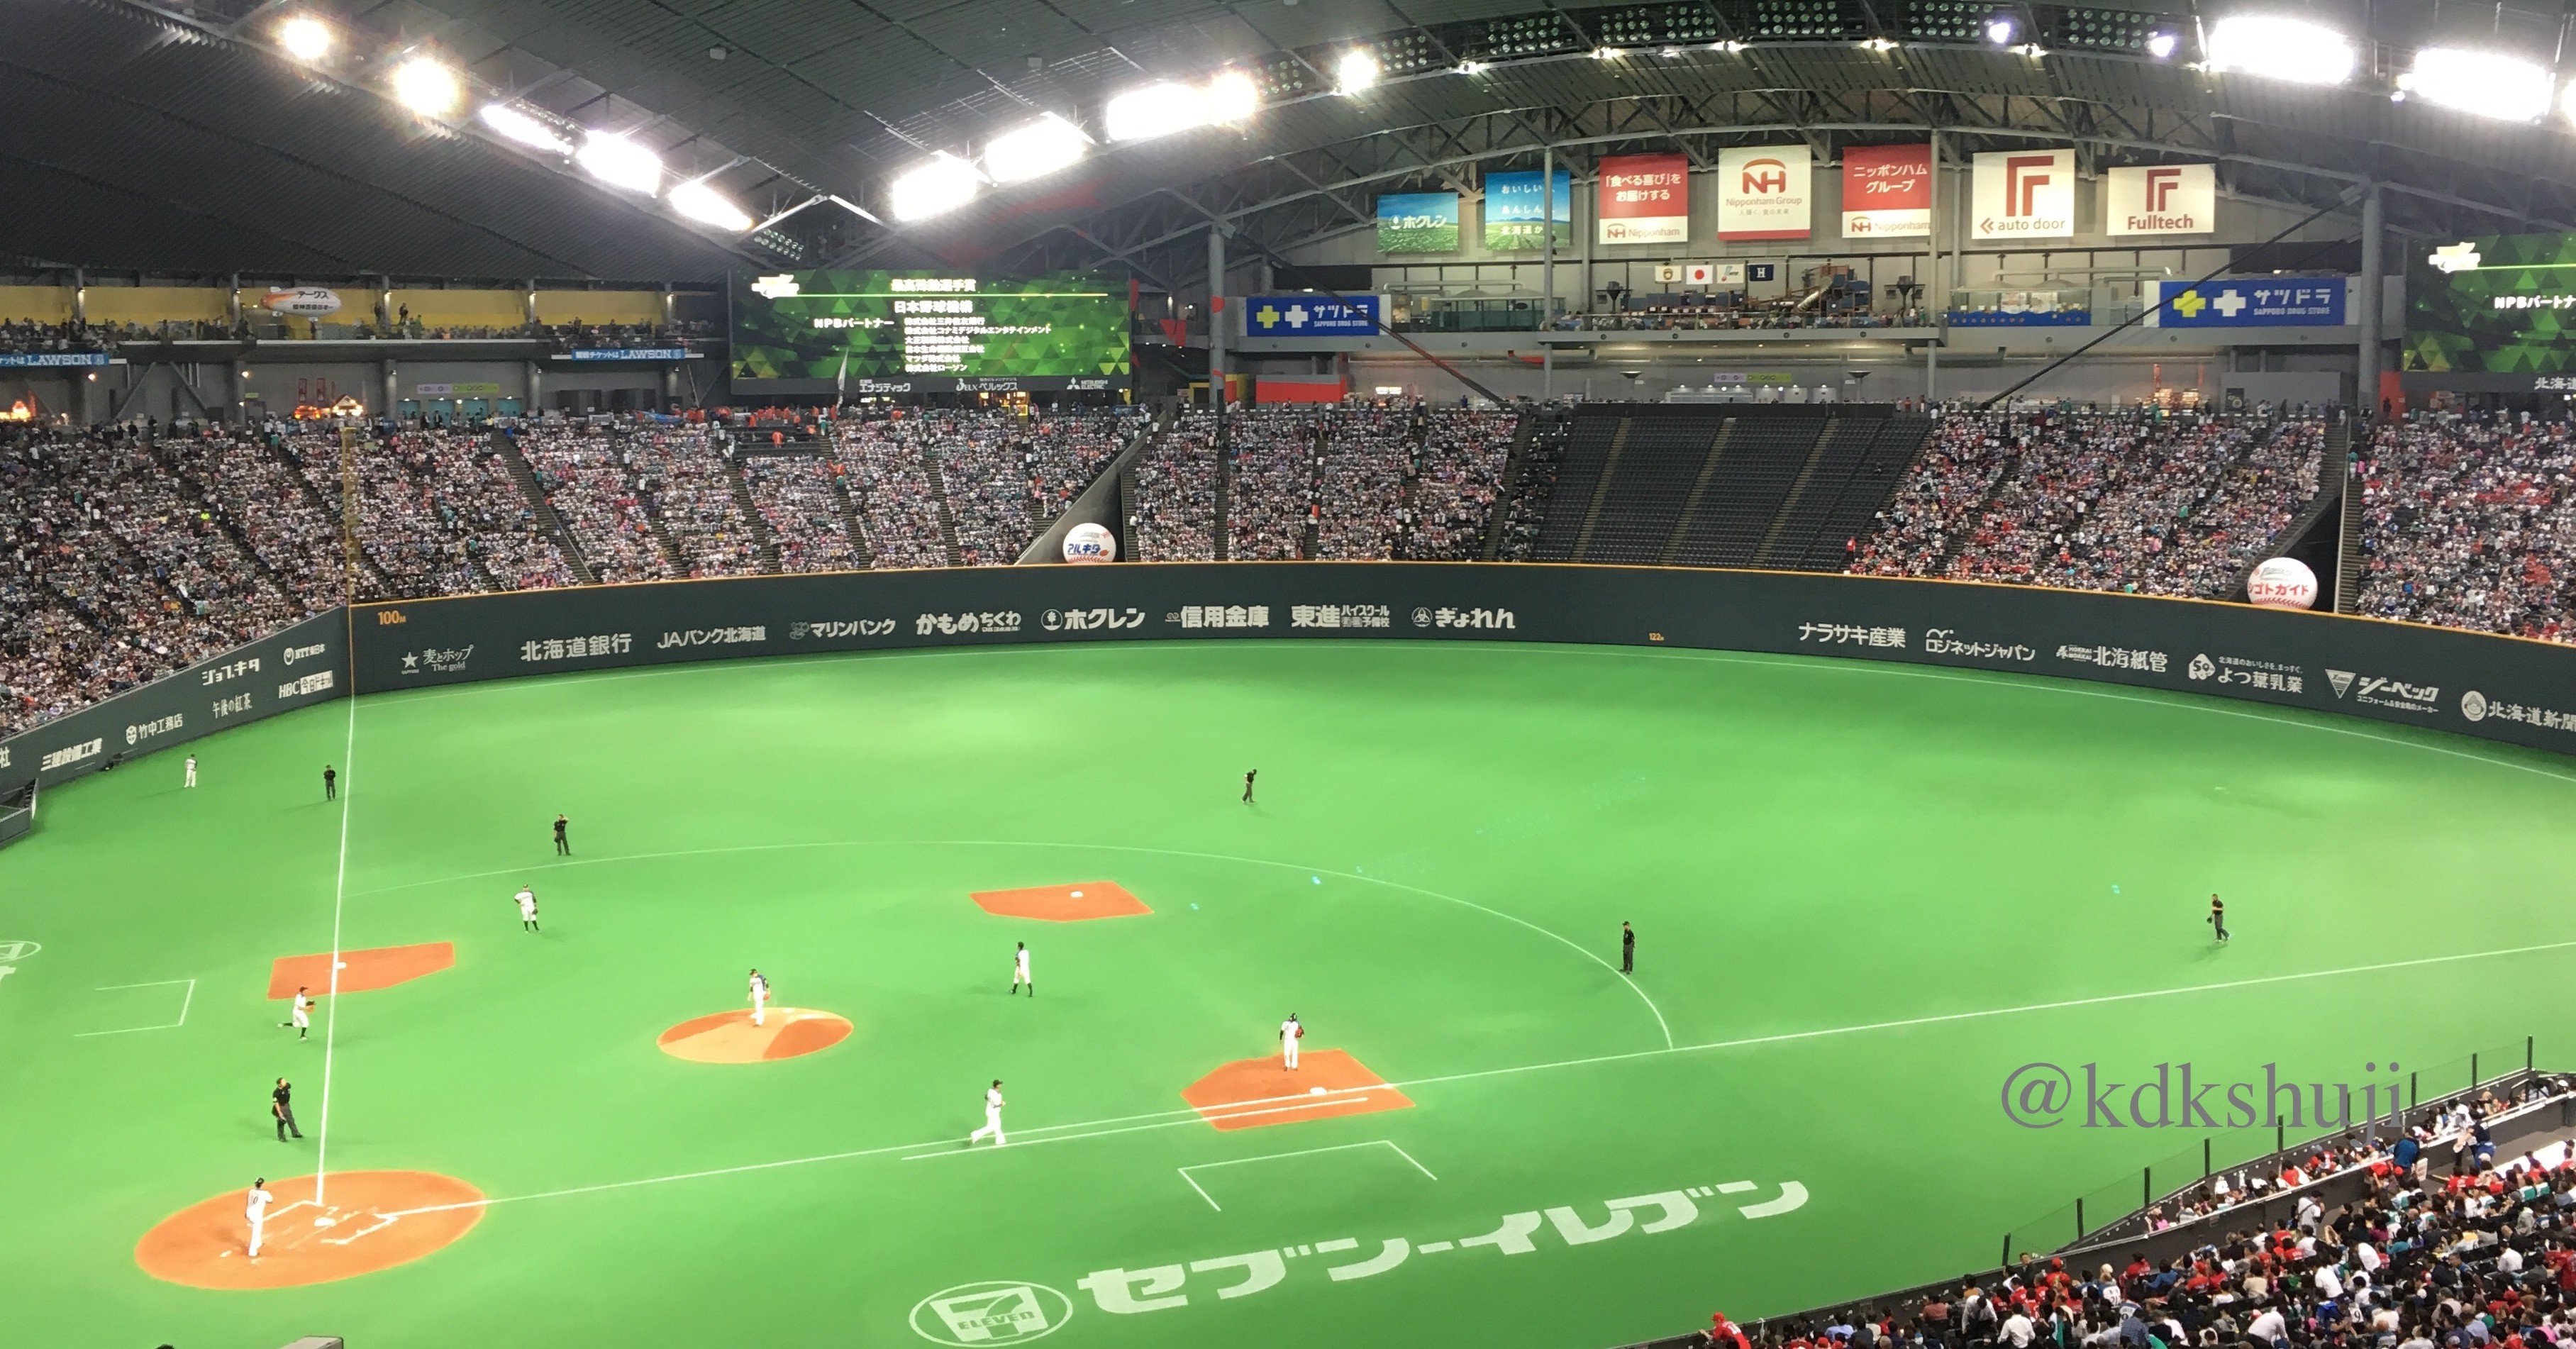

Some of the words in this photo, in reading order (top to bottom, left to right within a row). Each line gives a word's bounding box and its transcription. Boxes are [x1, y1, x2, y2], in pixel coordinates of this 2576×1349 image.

[1605, 173, 1681, 187] 「食べる喜び」を
[1853, 163, 1928, 178] ニッポンハム
[1742, 170, 1786, 194] NH
[1865, 179, 1915, 194] グループ
[1616, 189, 1670, 202] お届けする
[1726, 198, 1775, 208] Nipponham
[1776, 196, 1802, 206] Group
[1403, 215, 1448, 229] ホクレン
[1851, 222, 1871, 232] NH
[1874, 221, 1931, 233] Nipponham
[1998, 219, 2029, 231] auto
[2033, 218, 2066, 230] door
[2128, 214, 2194, 231] Fulltech
[1607, 226, 1626, 238] NH
[1628, 228, 1680, 239] Nipponham
[1756, 267, 1766, 278] H
[296, 291, 330, 299] アークス
[2254, 289, 2331, 305] サツドラ
[814, 317, 894, 328] NPBパートナー
[27, 355, 92, 366] LAWSON
[620, 350, 672, 359] LAWSON
[979, 382, 1018, 391] ベルックス
[1067, 543, 1101, 553] アルキタ
[916, 611, 1021, 635] かもめちくわ
[1064, 609, 1146, 630] ホクレン
[1180, 605, 1270, 628] 信用金庫
[1291, 605, 1340, 628] 東進
[1340, 604, 1390, 616] ハイスクール
[1435, 607, 1516, 629] ぎょれん
[657, 625, 767, 649] JAバンク北海道
[810, 618, 896, 638] マリンバンク
[1798, 622, 1906, 648] ナラサキ産業
[423, 644, 474, 665] 麦とホップ
[521, 633, 633, 662] 北海道銀行
[1926, 639, 2036, 661] ロジネットジャパン
[431, 663, 448, 672] The
[448, 660, 466, 672] gold
[2092, 645, 2168, 672] 北海紙管
[279, 680, 300, 699] HBC
[2218, 667, 2303, 694] よつ葉乳業
[2358, 677, 2440, 702] ジーベック
[213, 692, 252, 719] 午後の紅茶
[2488, 701, 2576, 733] 北海道新聞
[139, 714, 183, 740] 竹中工務店
[40, 738, 103, 772] 三建設備工業
